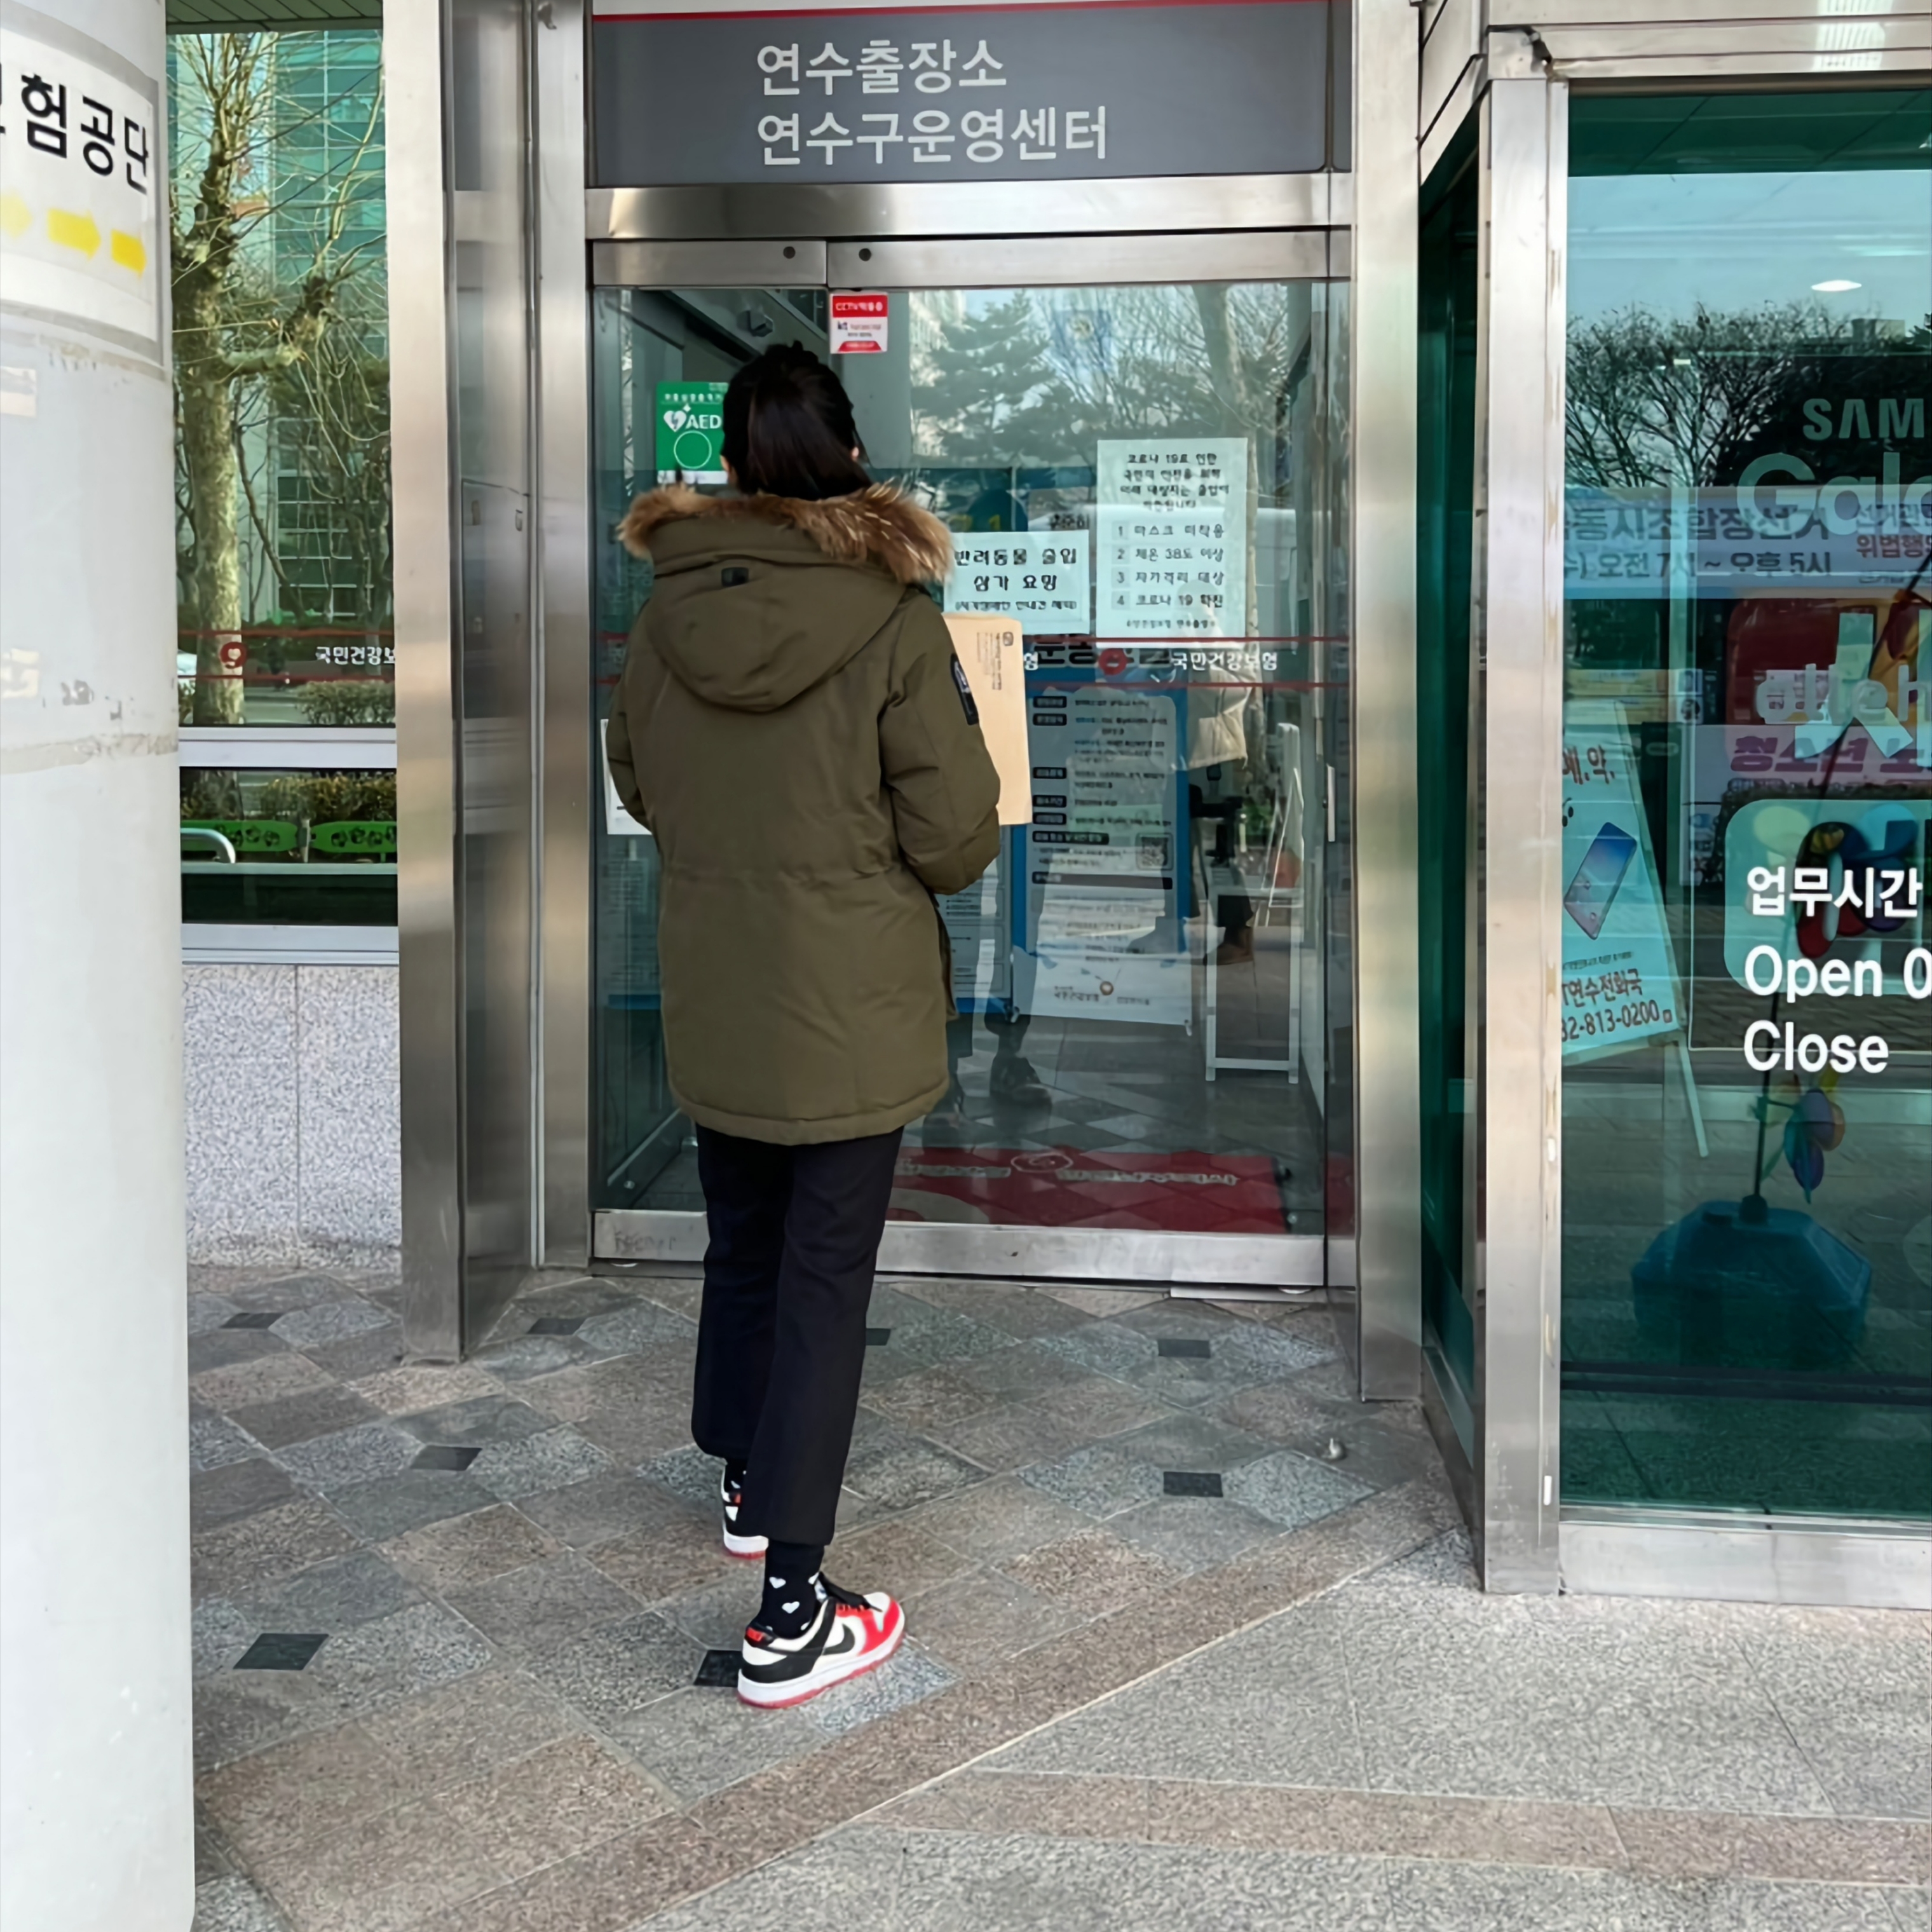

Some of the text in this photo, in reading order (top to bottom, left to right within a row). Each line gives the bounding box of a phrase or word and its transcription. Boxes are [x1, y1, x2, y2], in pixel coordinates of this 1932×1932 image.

[757, 39, 1007, 97] 연수출장소
[0, 62, 150, 195] 험공단
[758, 105, 1107, 166] 연수구운영센터
[685, 414, 722, 430] AED
[1802, 398, 1925, 440] SAM
[955, 548, 1077, 566] 반려동물 출입
[1117, 548, 1125, 560] 2
[1201, 548, 1224, 562] 이상
[1856, 534, 1932, 558] 위법행
[1599, 553, 1650, 578] 오전
[1731, 552, 1781, 578] 오후
[1790, 552, 1830, 576] 5시
[974, 575, 1058, 592] 삼가 요망
[1117, 571, 1125, 584] 3
[1198, 571, 1224, 586] 대상
[1117, 595, 1125, 606] 4
[1135, 594, 1172, 606] 코로나
[1178, 594, 1194, 606] 19
[1746, 866, 1923, 918] 업무시간
[1745, 944, 1884, 1003] Open
[1744, 1019, 1889, 1073] Close
